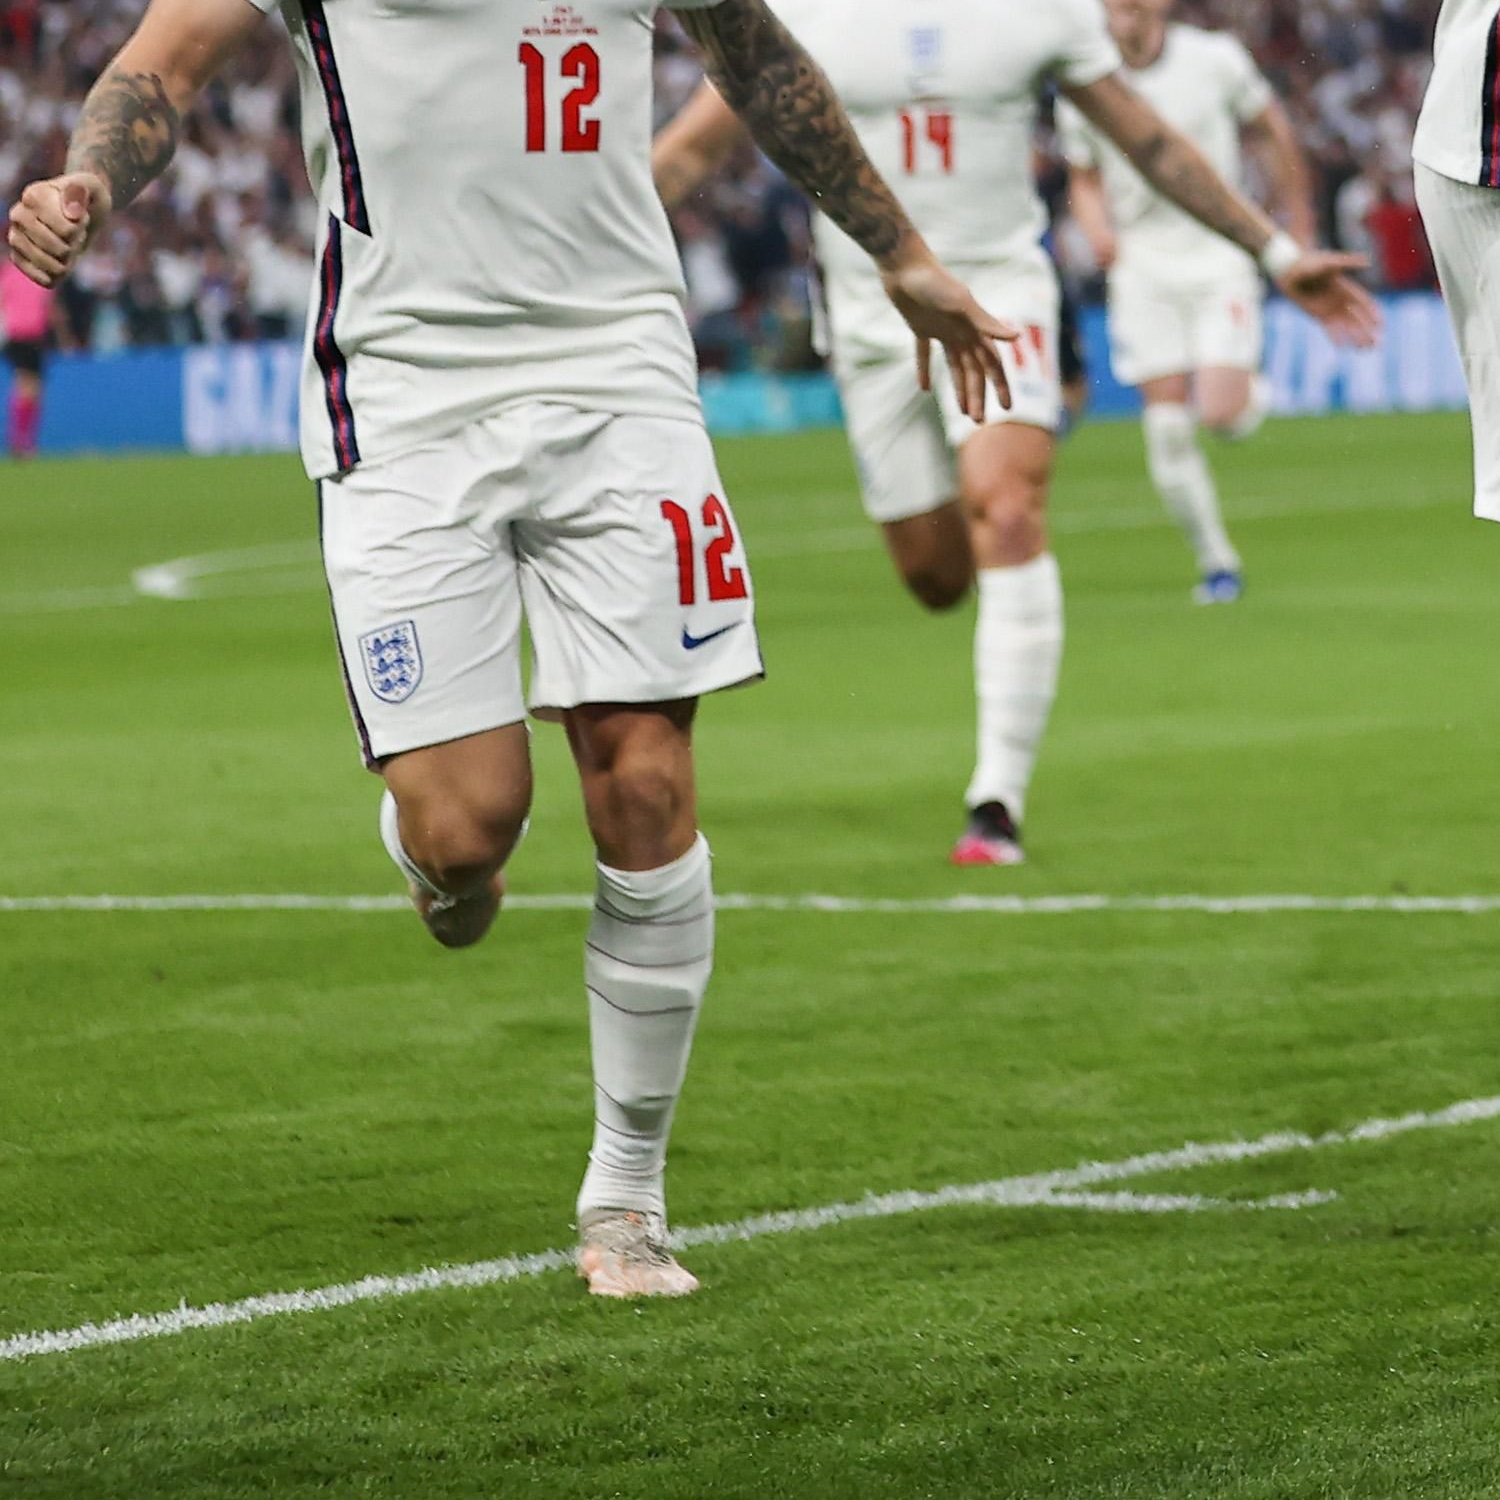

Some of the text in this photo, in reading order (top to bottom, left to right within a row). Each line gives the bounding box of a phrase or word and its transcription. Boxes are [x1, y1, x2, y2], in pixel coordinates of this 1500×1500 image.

[518, 42, 601, 153] 12
[898, 107, 954, 174] 14
[660, 493, 748, 605] 12
